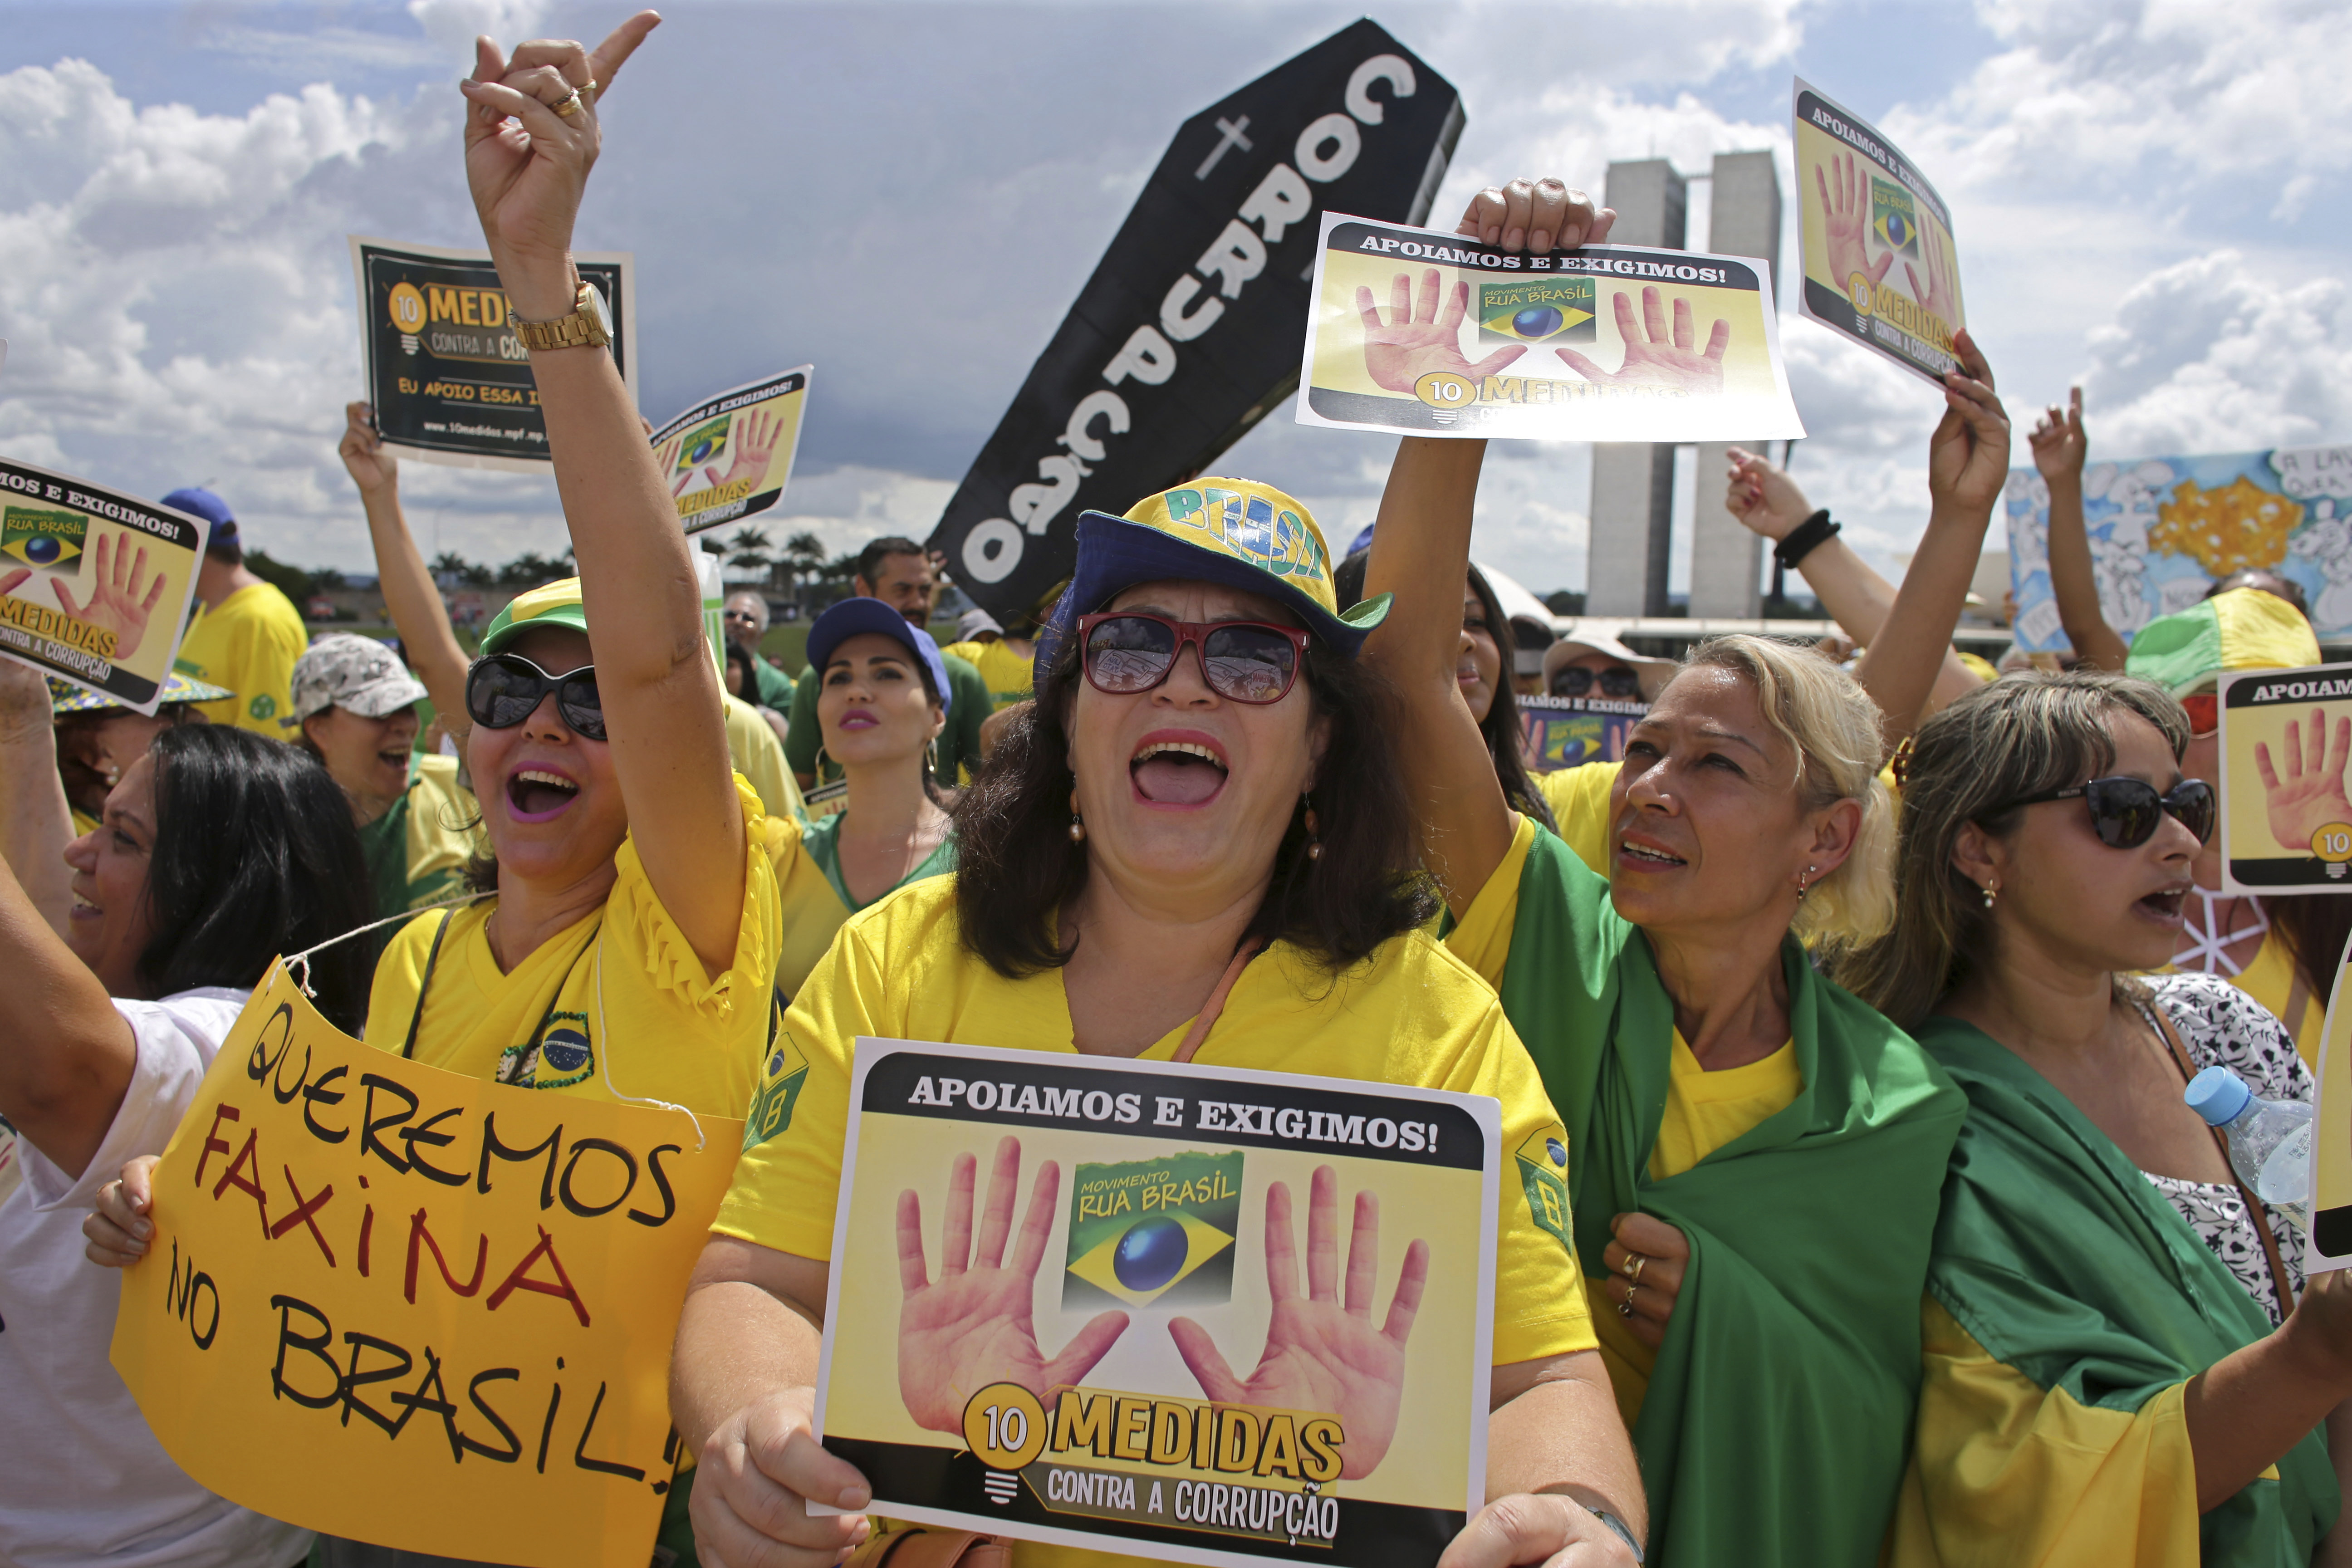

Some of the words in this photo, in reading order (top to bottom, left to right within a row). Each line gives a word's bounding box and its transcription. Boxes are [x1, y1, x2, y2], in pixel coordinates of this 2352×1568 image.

[1812, 107, 1886, 164] APOIAMOS
[1888, 154, 1897, 173] E
[1874, 191, 1889, 205] RUA
[1360, 235, 1522, 270] APOIAMOS
[1530, 256, 1551, 270] E
[1560, 256, 1727, 284] EXIGIMOS!
[1485, 285, 1545, 296] MOVIMENTO
[1485, 295, 1521, 308] RUA
[397, 295, 418, 323] 10
[1854, 282, 1868, 307] 10
[1875, 283, 1955, 353] MEDIDAS
[431, 332, 481, 356] CONTRA
[486, 337, 495, 357] A
[1875, 319, 1902, 348] CONTRA
[1904, 336, 1910, 352] A
[398, 377, 418, 395] EU
[424, 381, 475, 401] APOIO
[480, 385, 523, 405] ESSA
[1430, 381, 1463, 402] 10
[652, 409, 706, 446] APOIAMOS
[707, 404, 718, 416] E
[719, 380, 792, 412] EXIGIMOS!
[6, 519, 34, 530] RUA
[45, 484, 62, 500] E
[66, 490, 180, 539] EXIGIMOS!
[0, 594, 119, 657] MEDIDAS
[34, 639, 42, 653] A
[45, 641, 111, 681] CORRUPÇÃO
[1573, 698, 1585, 710] E
[2323, 832, 2351, 855] 10
[247, 1001, 682, 1227] QUEREMOS
[908, 1076, 1141, 1126] APOIAMOS
[1153, 1097, 1184, 1128] E
[1196, 1100, 1440, 1153] EXIGIMOS!
[1080, 1171, 1170, 1193] MOVIMENTO
[1078, 1192, 1131, 1222] RUA
[167, 1235, 220, 1351] NO
[980, 1403, 1028, 1451] 10
[1051, 1391, 1345, 1484] MEDIDAS
[1047, 1468, 1137, 1513] CONTRA
[1148, 1486, 1163, 1515] A
[1174, 1482, 1338, 1548] CORRUPÇÃO
